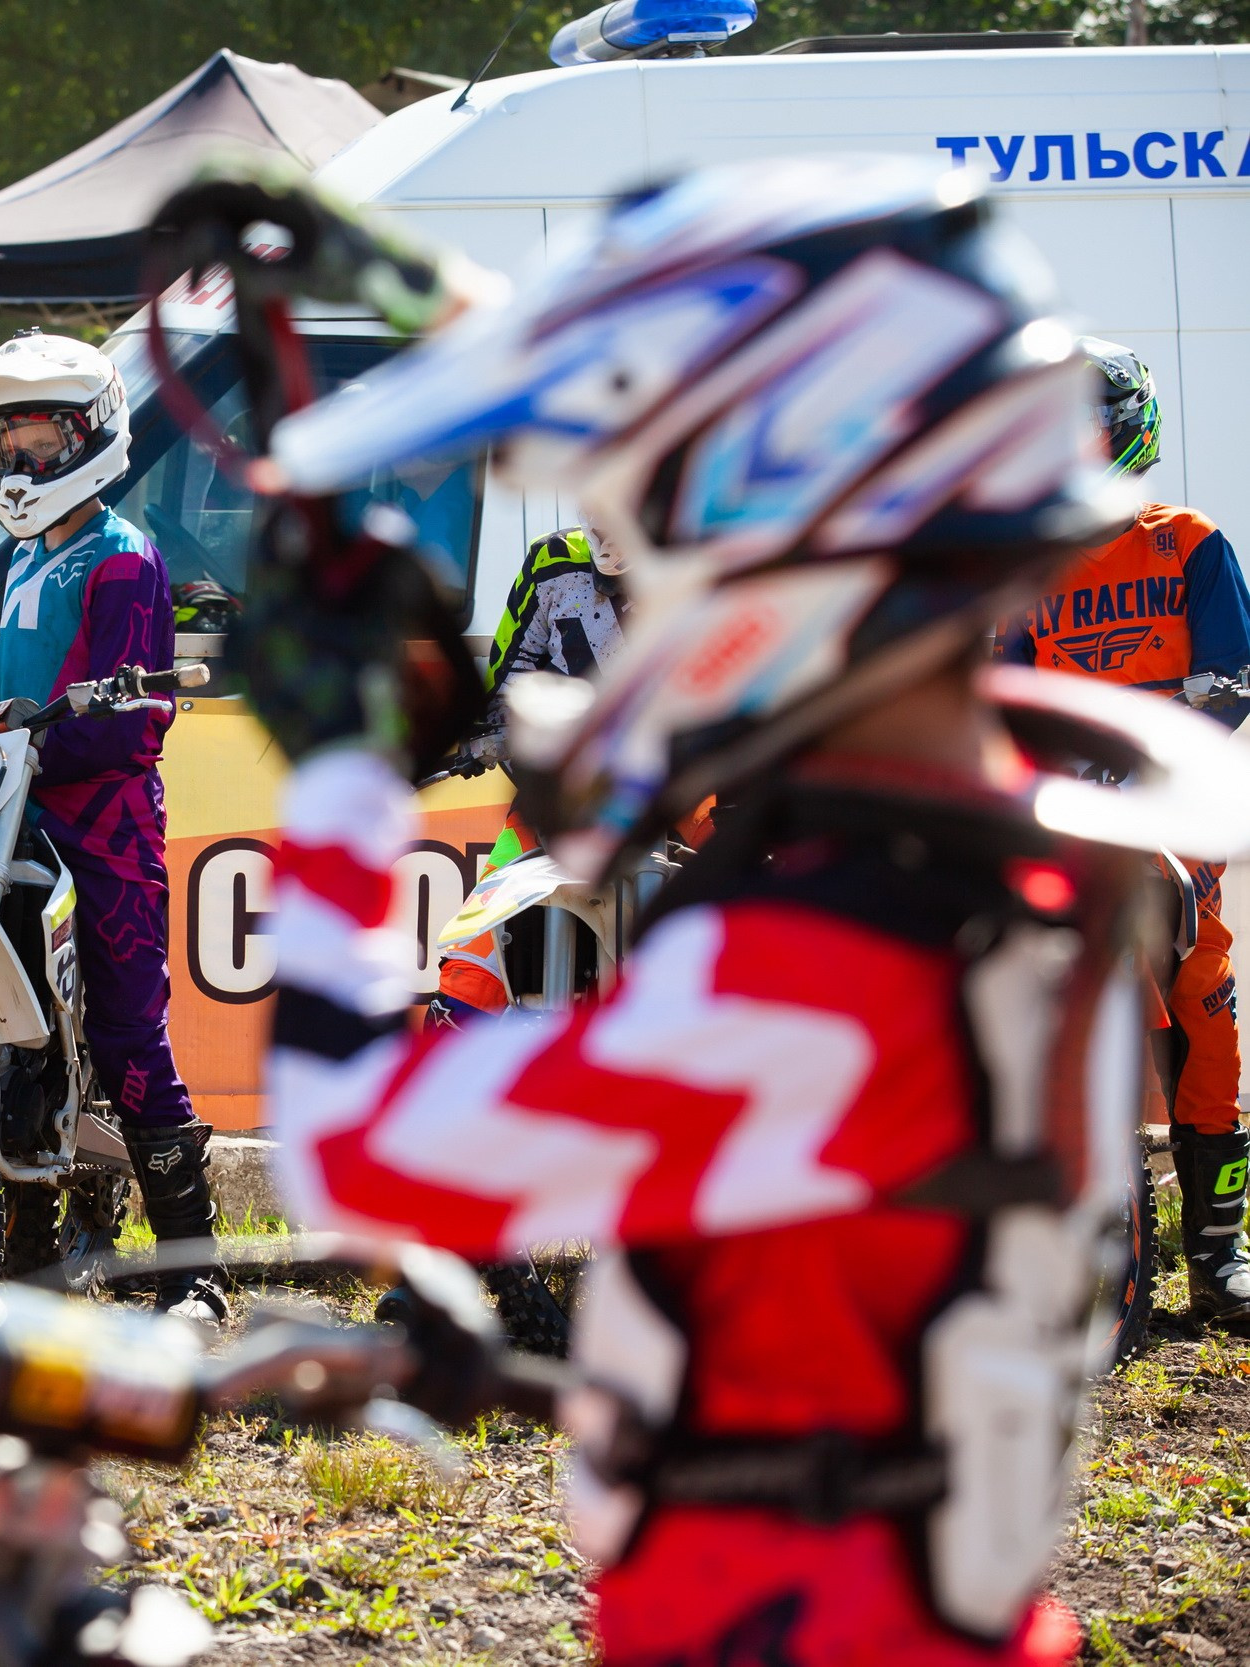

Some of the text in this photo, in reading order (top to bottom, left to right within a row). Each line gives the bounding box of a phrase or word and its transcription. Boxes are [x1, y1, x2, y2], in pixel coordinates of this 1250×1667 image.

[936, 131, 1250, 182] ТУЛЬСК
[1073, 576, 1185, 629] RACING
[120, 1059, 150, 1114] FOX
